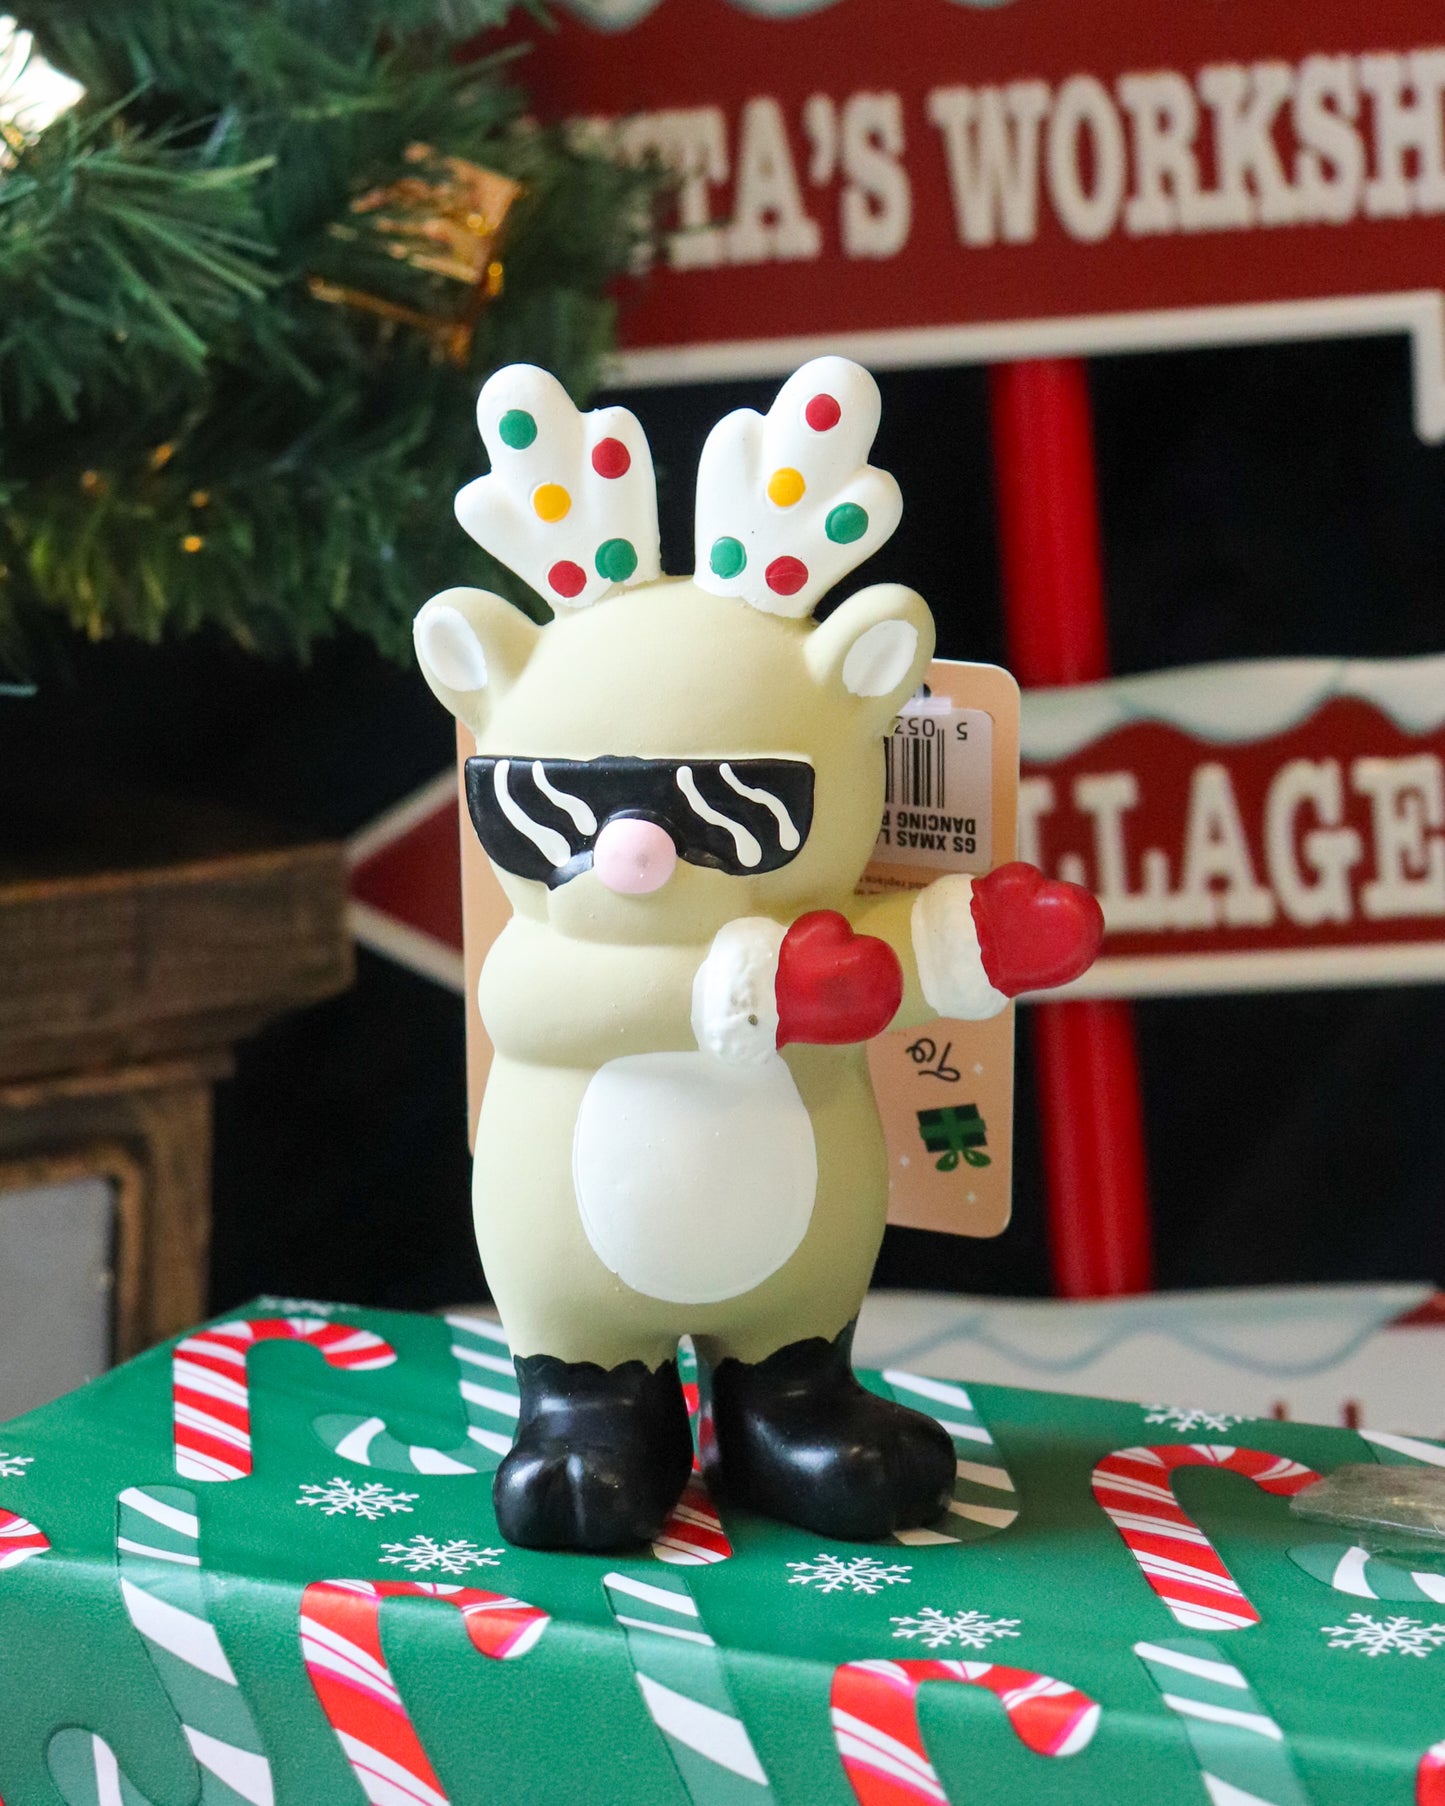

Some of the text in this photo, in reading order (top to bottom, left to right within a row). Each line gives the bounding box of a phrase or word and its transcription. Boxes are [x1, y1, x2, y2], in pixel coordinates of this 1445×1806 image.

[566, 93, 912, 275] TA'S
[957, 722, 968, 740] 5
[897, 811, 976, 835] DANCING
[897, 831, 946, 850] XMAS
[953, 837, 976, 854] GS
[906, 1038, 961, 1082] To
